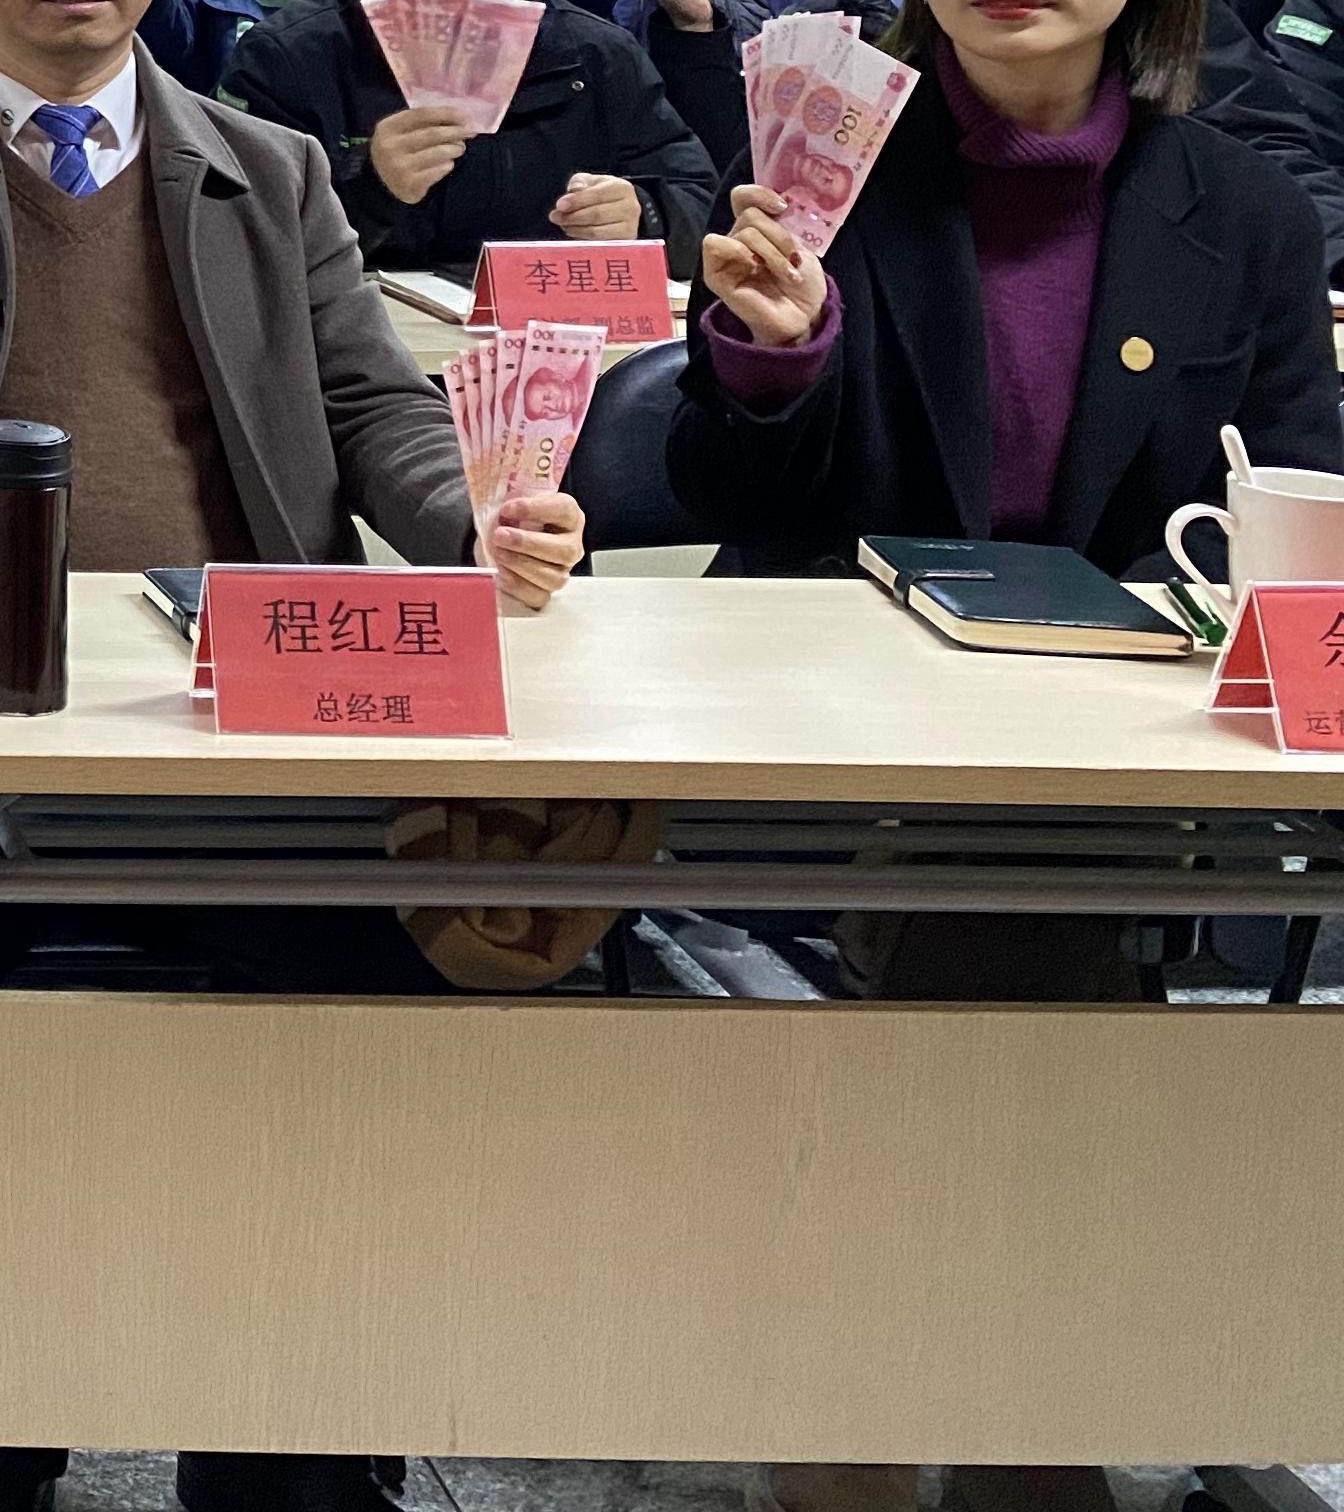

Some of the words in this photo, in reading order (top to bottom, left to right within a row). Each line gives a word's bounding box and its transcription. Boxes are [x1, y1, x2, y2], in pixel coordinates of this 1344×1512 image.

[834, 105, 863, 146] 100
[524, 258, 639, 294] 李星星
[535, 437, 555, 479] 100
[263, 599, 449, 656] 程红星
[313, 692, 414, 724] 总经理
[1304, 708, 1344, 735] 运
